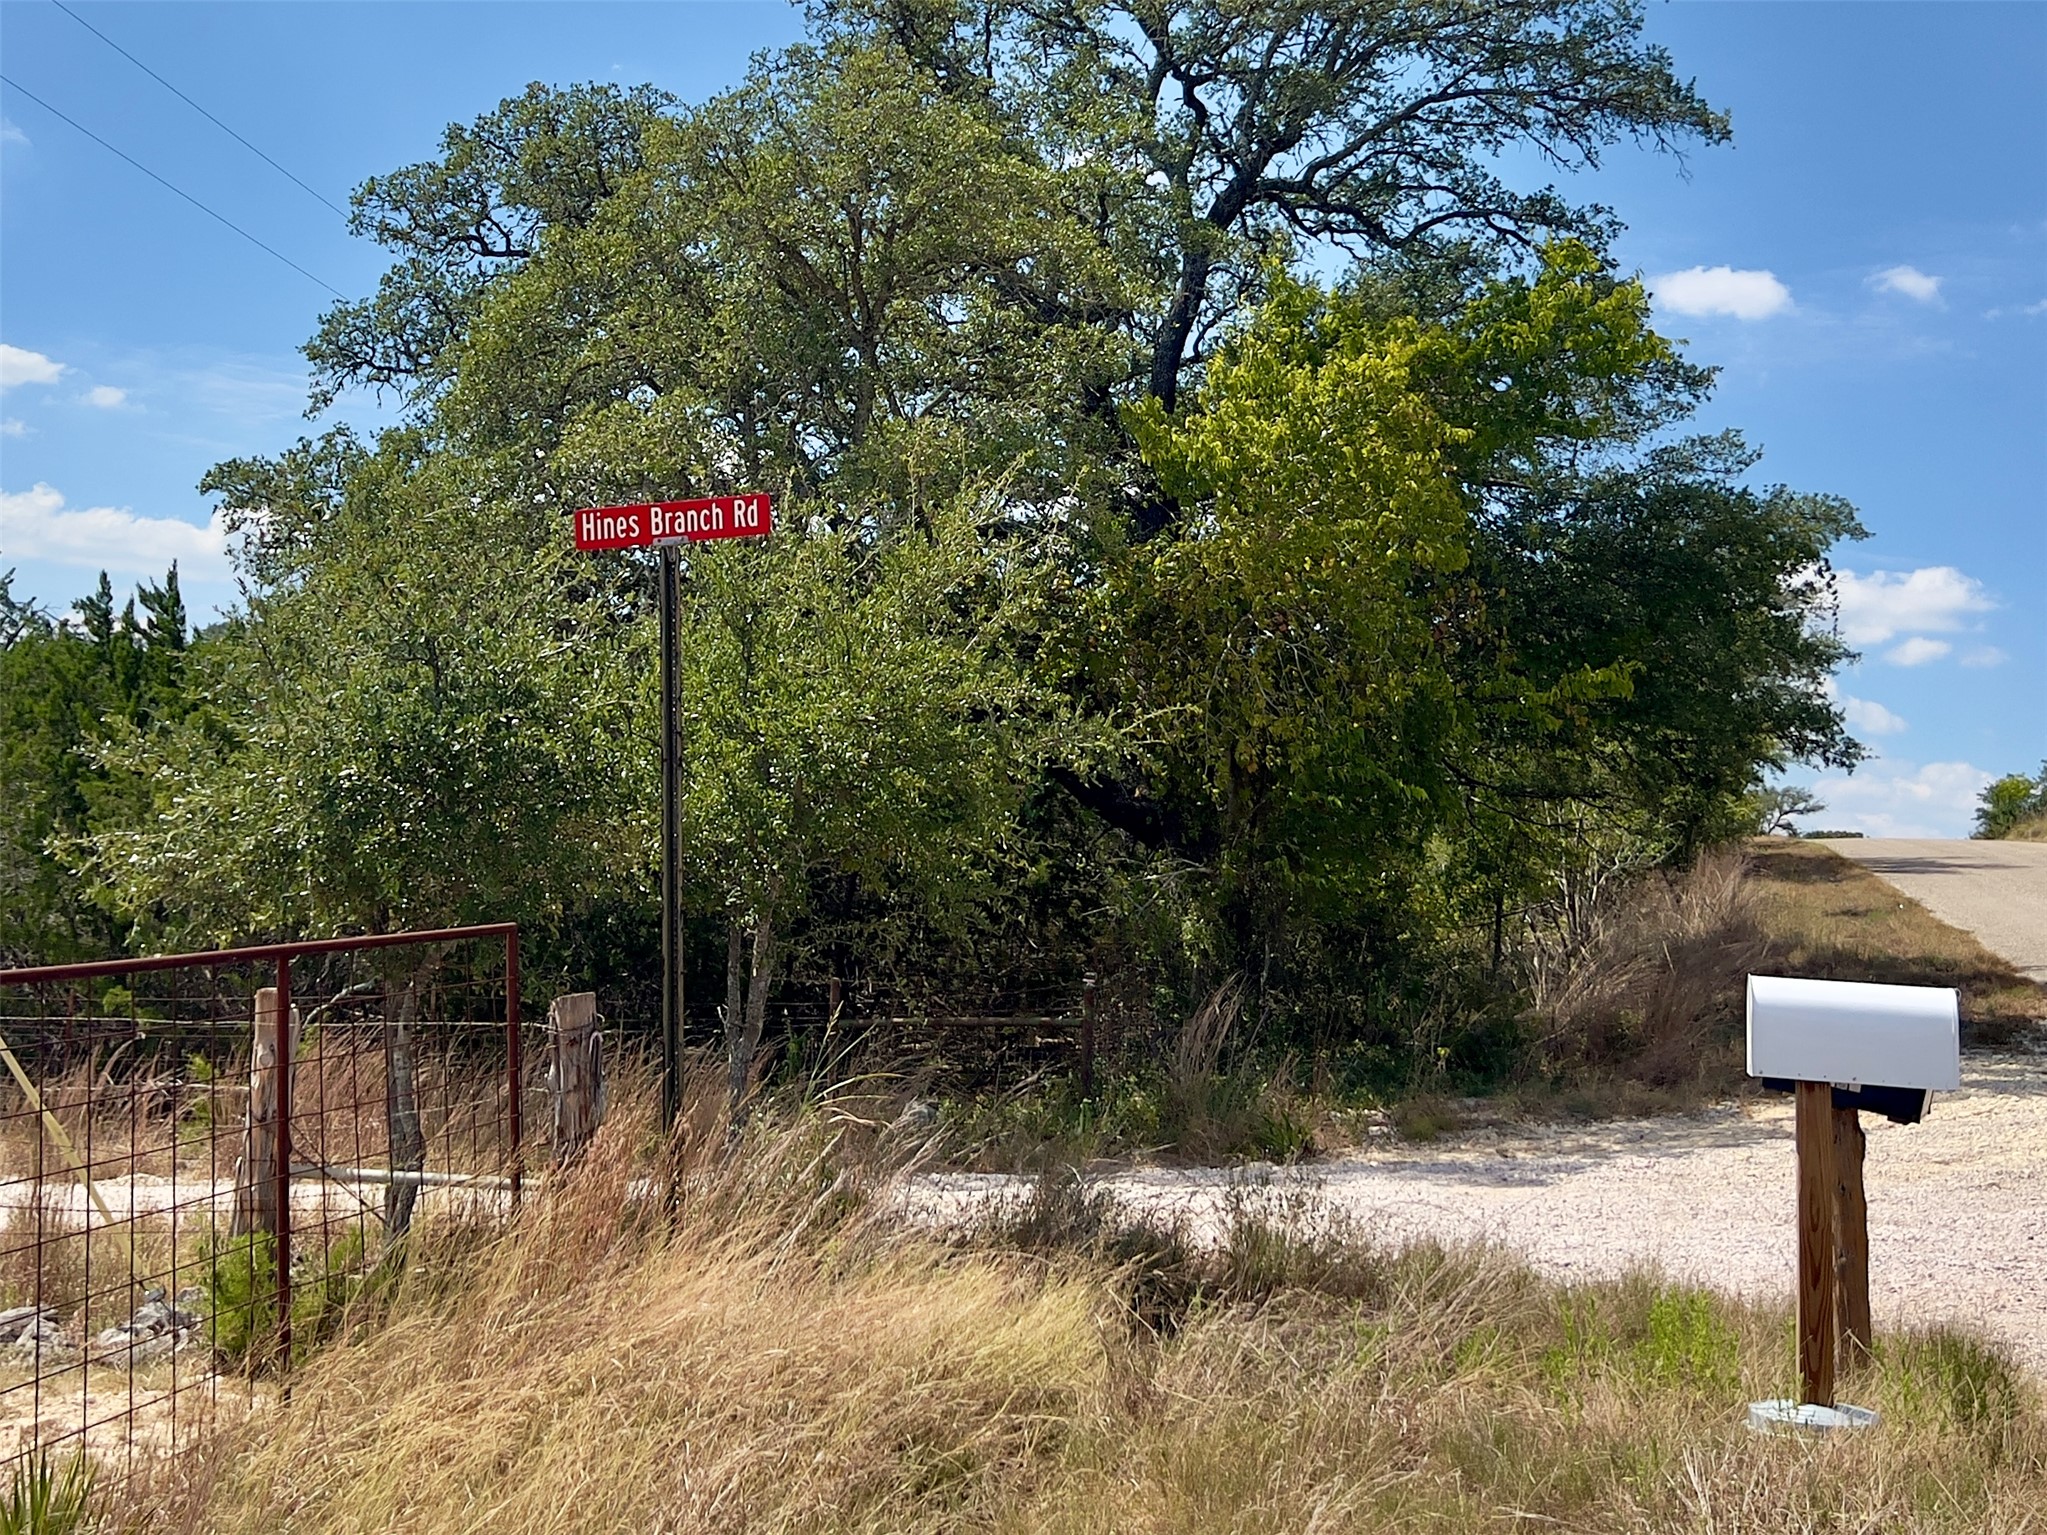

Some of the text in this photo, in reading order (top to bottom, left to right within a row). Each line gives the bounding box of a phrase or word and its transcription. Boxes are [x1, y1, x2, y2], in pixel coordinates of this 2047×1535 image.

[582, 498, 759, 542] Hines Branch Rd
